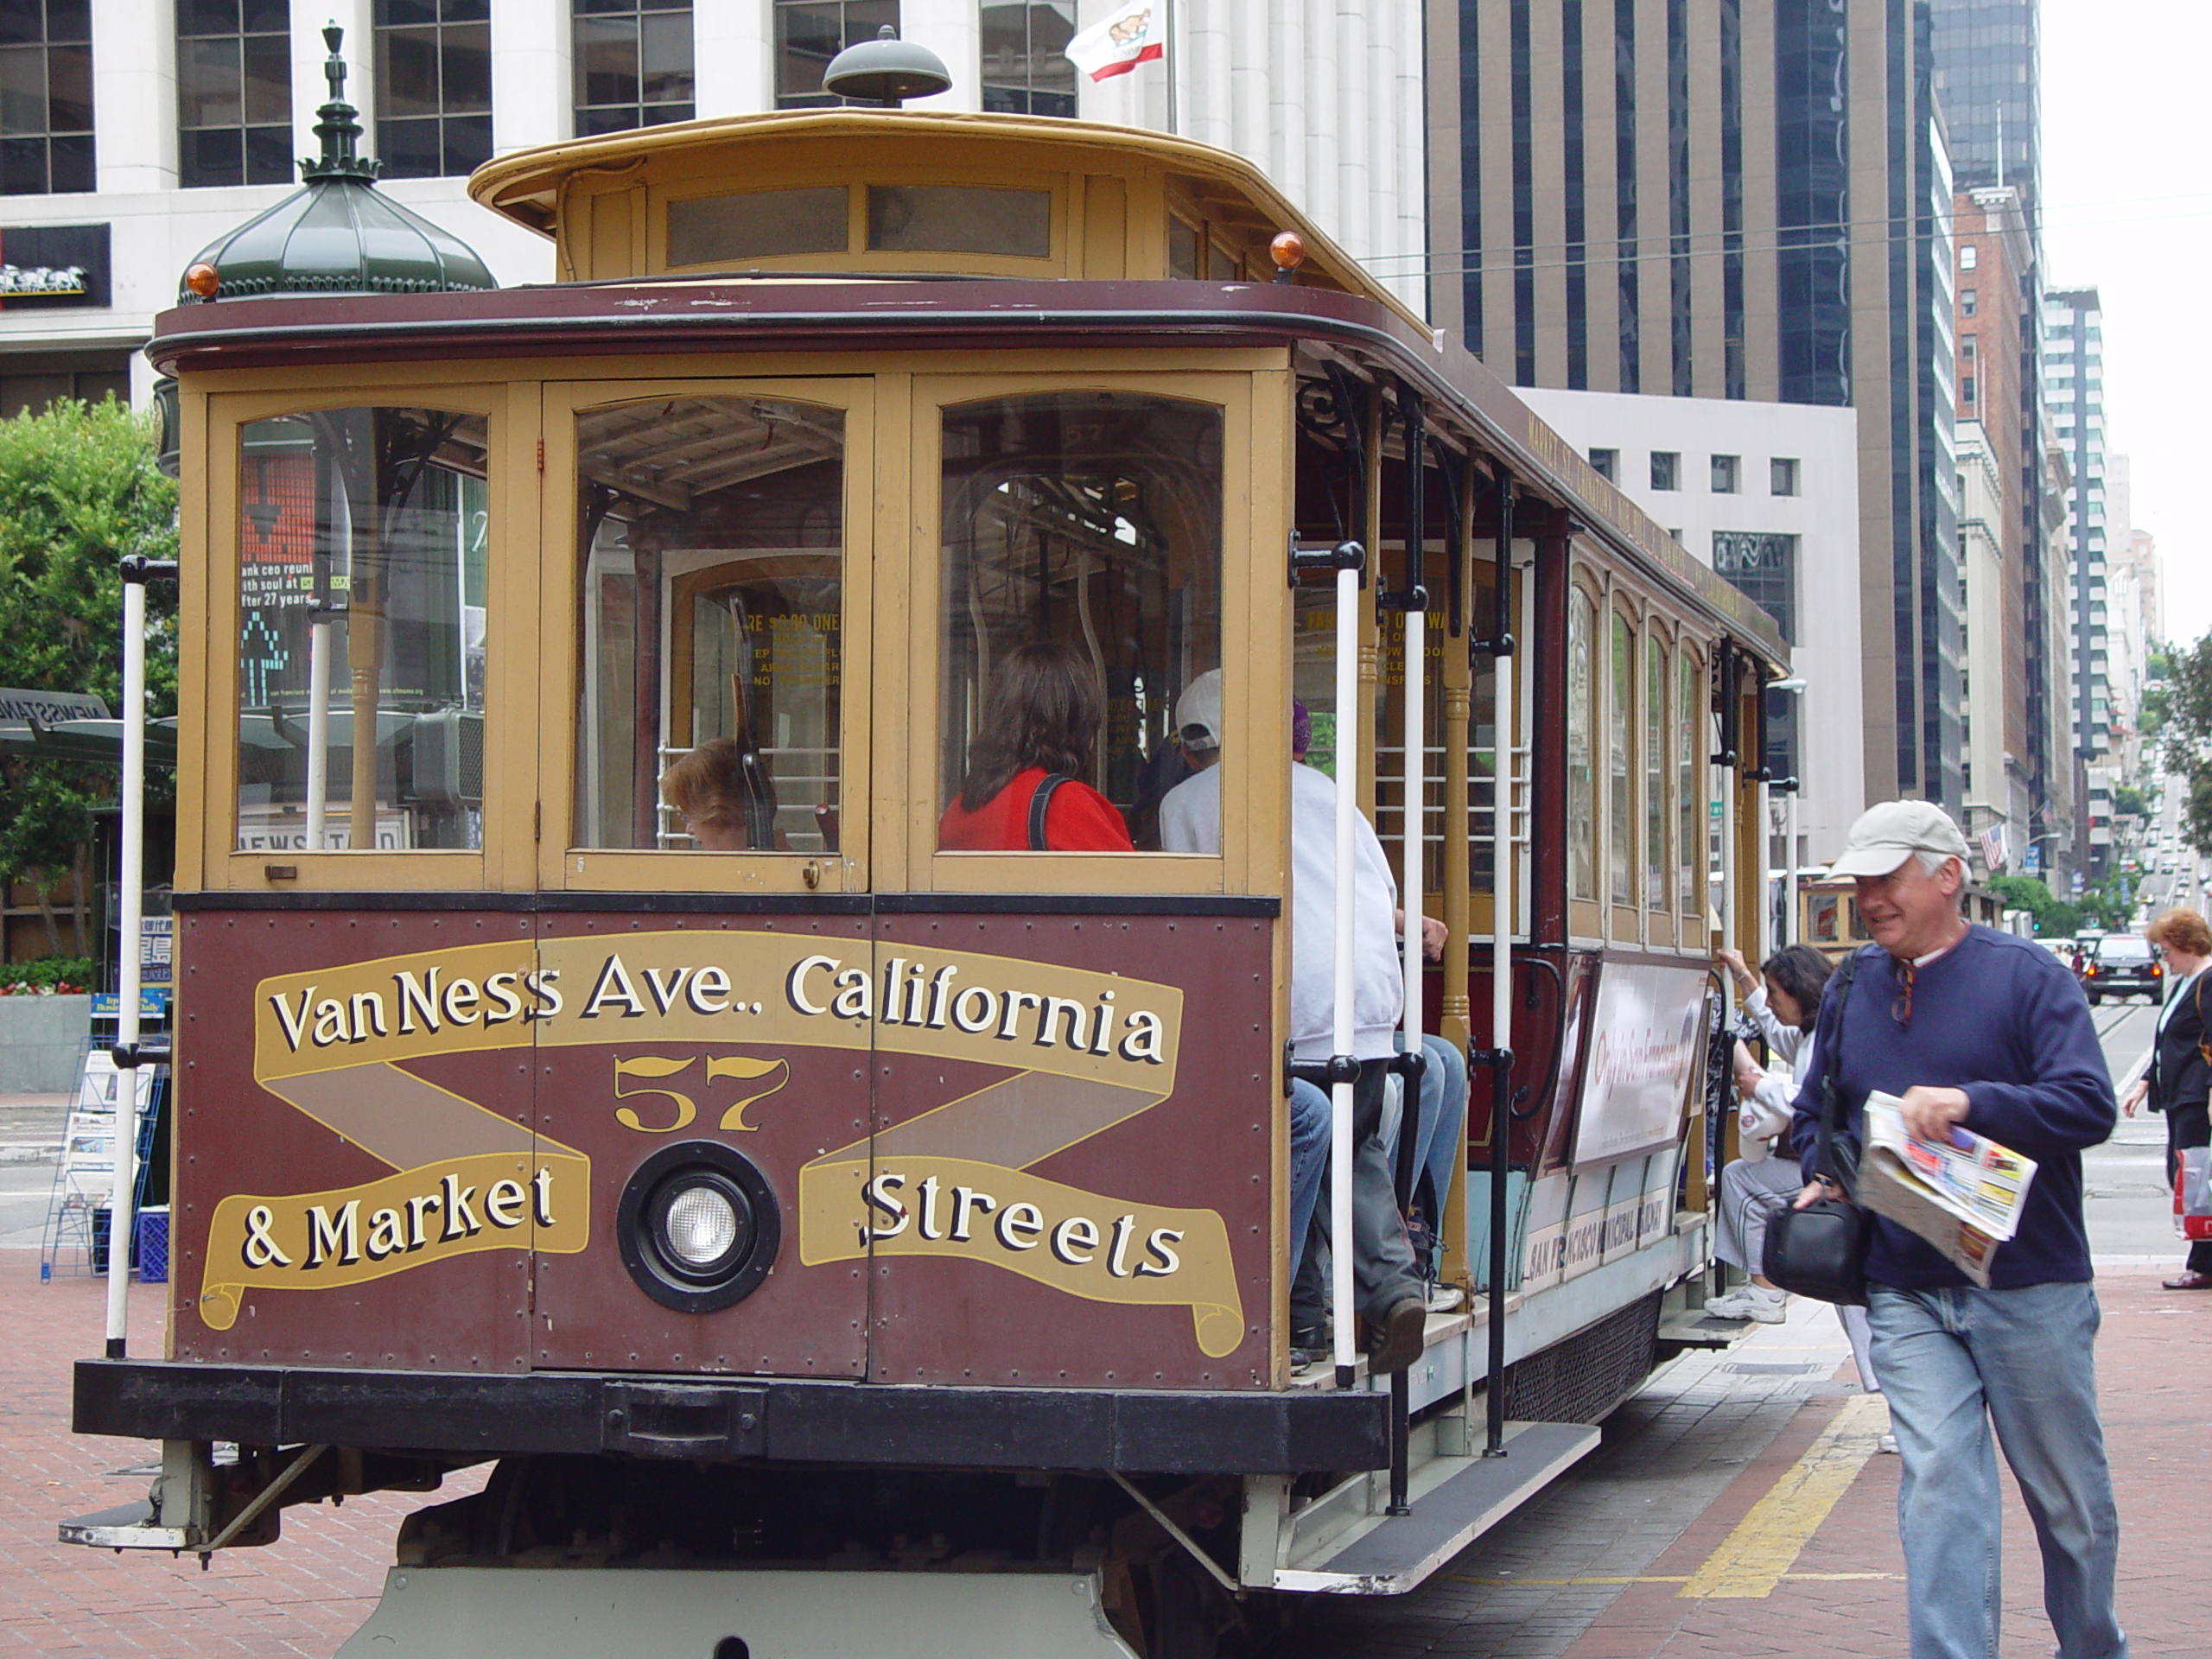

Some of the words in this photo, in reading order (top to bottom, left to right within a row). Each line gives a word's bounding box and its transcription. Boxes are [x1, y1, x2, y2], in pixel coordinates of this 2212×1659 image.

[1528, 410, 1558, 472] MARKET
[242, 563, 258, 576] ank
[262, 565, 281, 575] ceo
[243, 578, 258, 592] ith
[261, 577, 283, 591] soul
[286, 577, 298, 589] at
[242, 594, 261, 607] fter
[264, 593, 277, 606] 27
[813, 613, 839, 631] ONE
[1307, 611, 1335, 629] FAR
[1427, 612, 1445, 630] WA
[753, 677, 772, 686] NO
[269, 986, 388, 1052] Van
[391, 966, 563, 1035] Ness
[785, 955, 1165, 1065] California
[613, 1052, 791, 1133] 57
[241, 1205, 293, 1269] &
[300, 1168, 557, 1270] Market
[859, 1173, 1185, 1280] Streets
[1529, 1239, 1550, 1281] SAN
